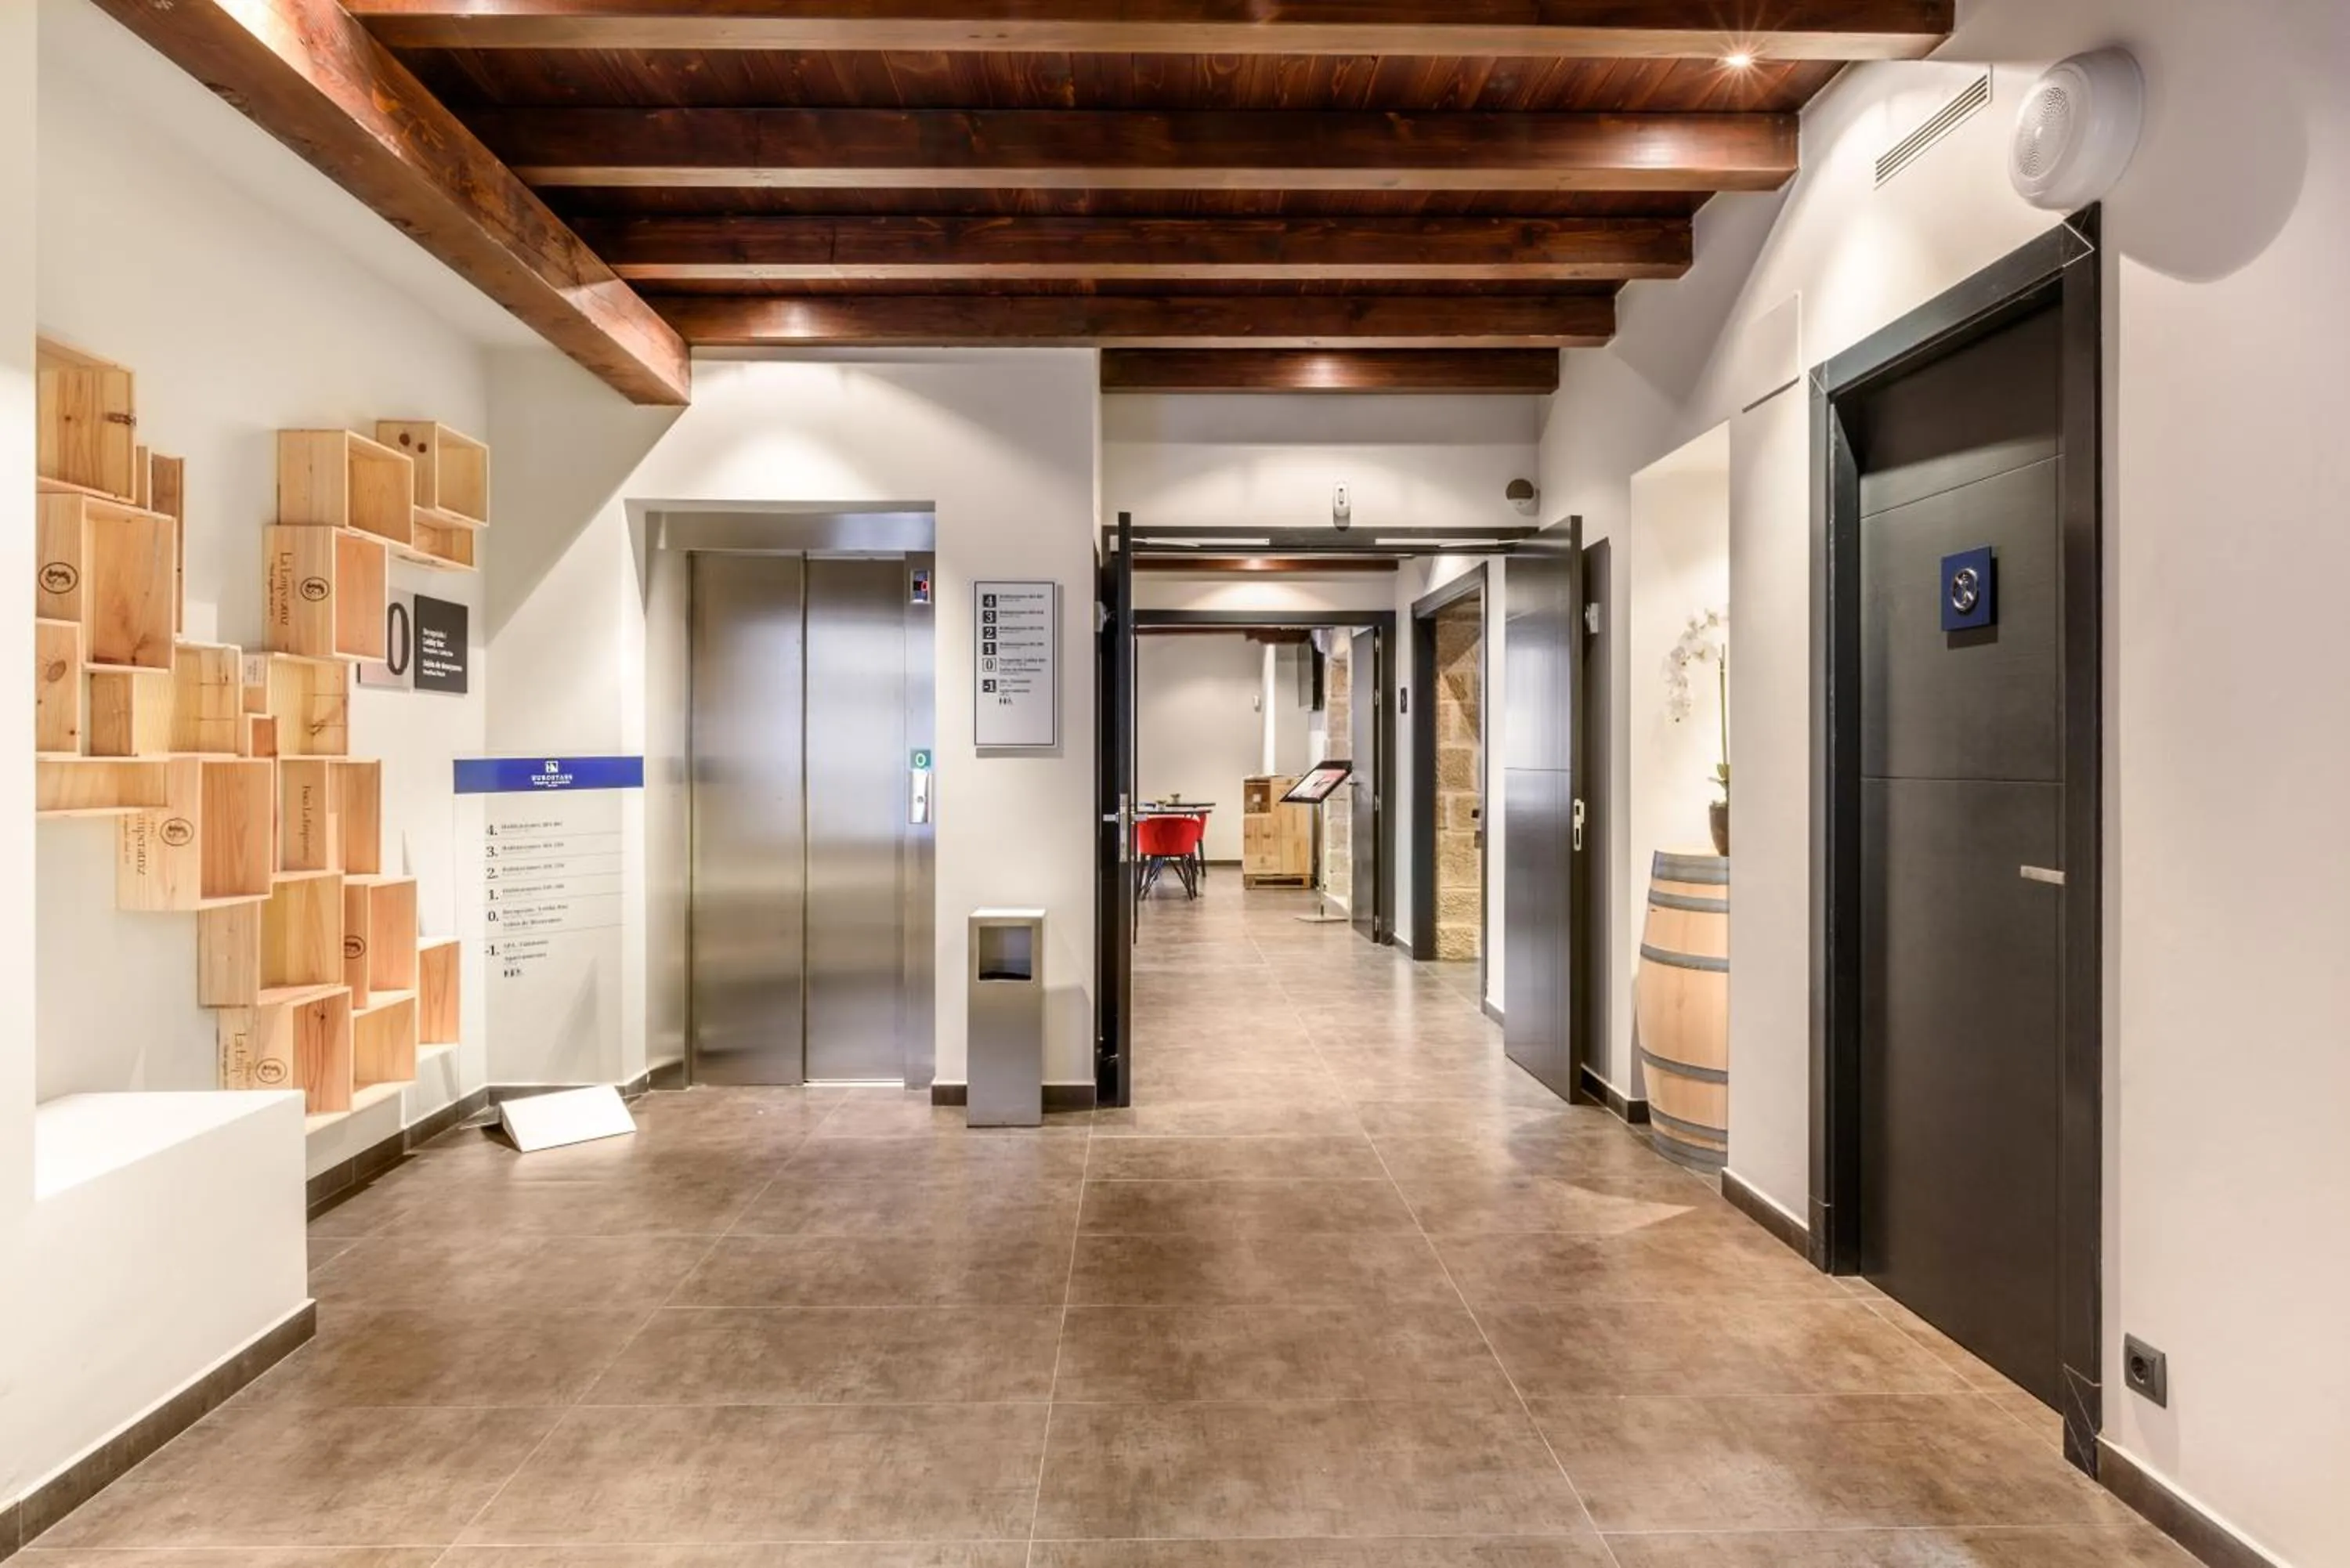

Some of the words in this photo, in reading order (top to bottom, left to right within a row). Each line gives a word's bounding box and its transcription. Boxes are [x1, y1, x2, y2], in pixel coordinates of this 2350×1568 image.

[985, 611, 993, 623] 3
[985, 627, 993, 638] 2
[387, 602, 410, 676] 0
[985, 659, 993, 670] 0
